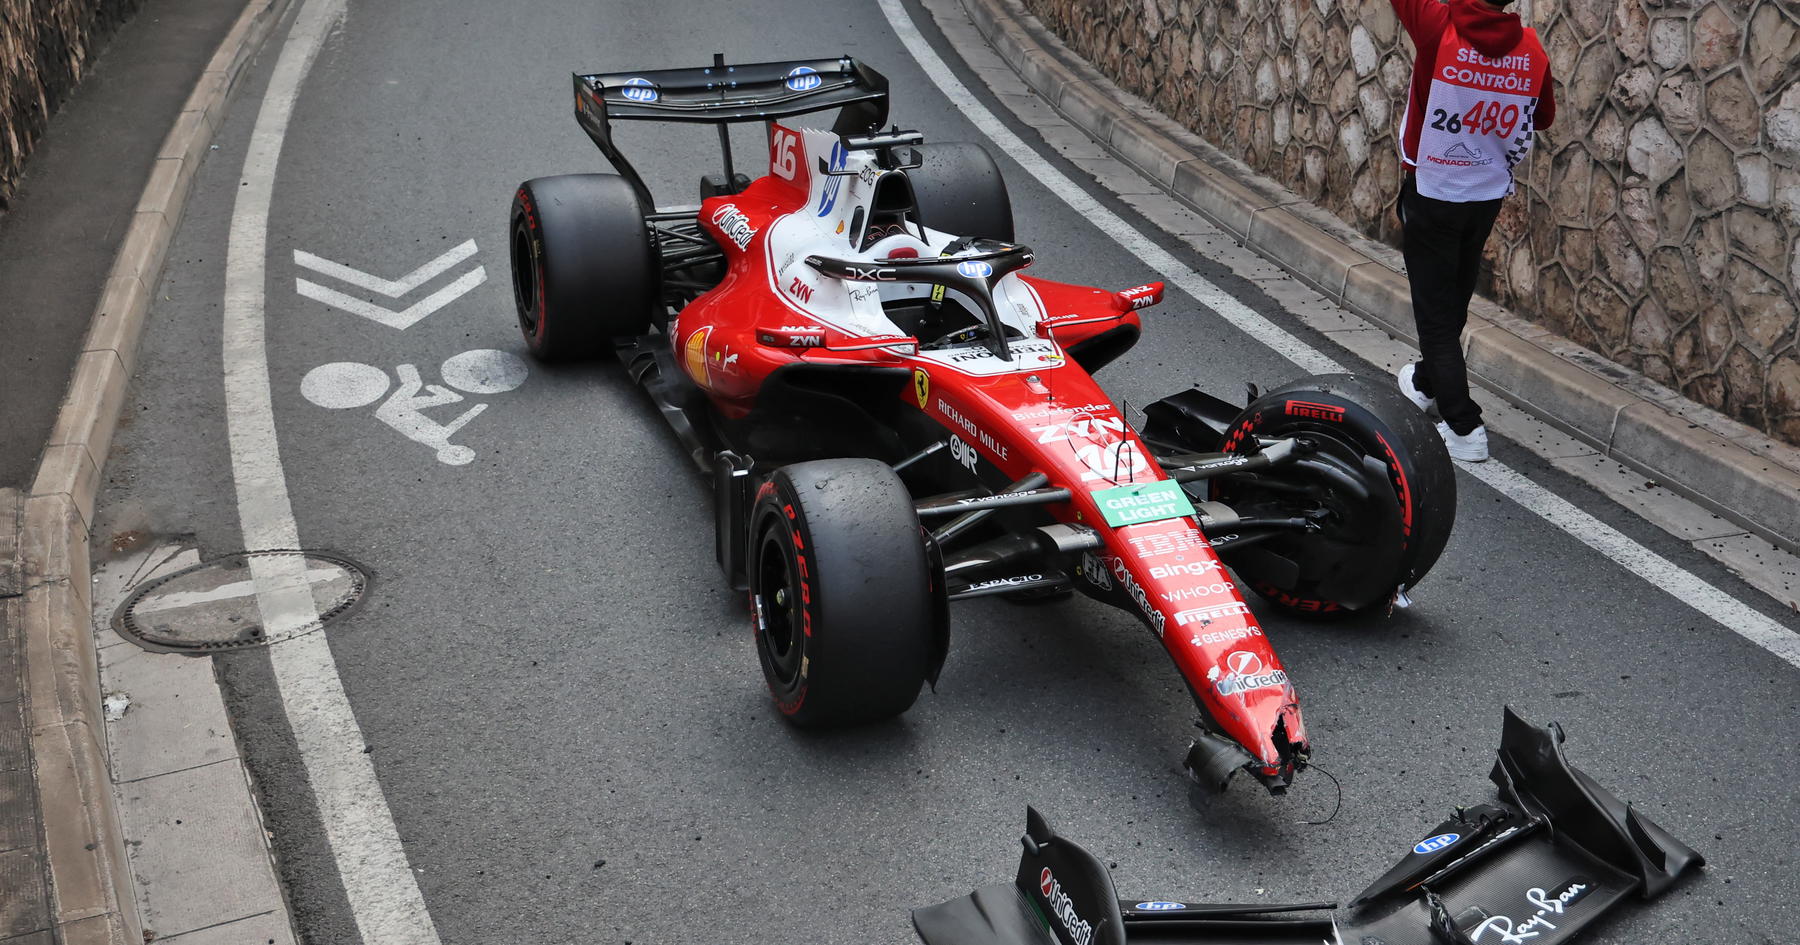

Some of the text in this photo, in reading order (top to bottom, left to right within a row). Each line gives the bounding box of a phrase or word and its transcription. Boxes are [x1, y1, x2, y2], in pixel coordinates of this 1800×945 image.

[1456, 47, 1530, 72] SÉCURITÉ
[625, 77, 655, 101] hp
[788, 66, 820, 91] hp
[1442, 65, 1531, 92] CONTRÔLE
[772, 129, 796, 181] 16
[959, 260, 991, 278] hp
[789, 276, 815, 305] ZYN
[1132, 295, 1153, 309] ZYN
[790, 335, 821, 346] ZYN
[1010, 403, 1112, 422] Bitdefender
[1285, 400, 1346, 423] PIRELLI
[938, 398, 1008, 462] RICHARD MILLE
[1030, 416, 1130, 445] ZYN
[1076, 440, 1146, 482] 16
[978, 489, 1037, 502] vantage
[1106, 489, 1178, 510] GREEN
[1117, 503, 1176, 522] LIGHT
[1128, 528, 1210, 559] IBM
[968, 573, 1043, 591] ESPACIO
[1161, 582, 1235, 602] WHOOP
[1123, 569, 1166, 638] UniCredit
[1174, 601, 1250, 627] PIRELLI
[1202, 626, 1262, 644] GENESYS
[1416, 834, 1458, 853] hp
[1050, 878, 1093, 945] UniCredit
